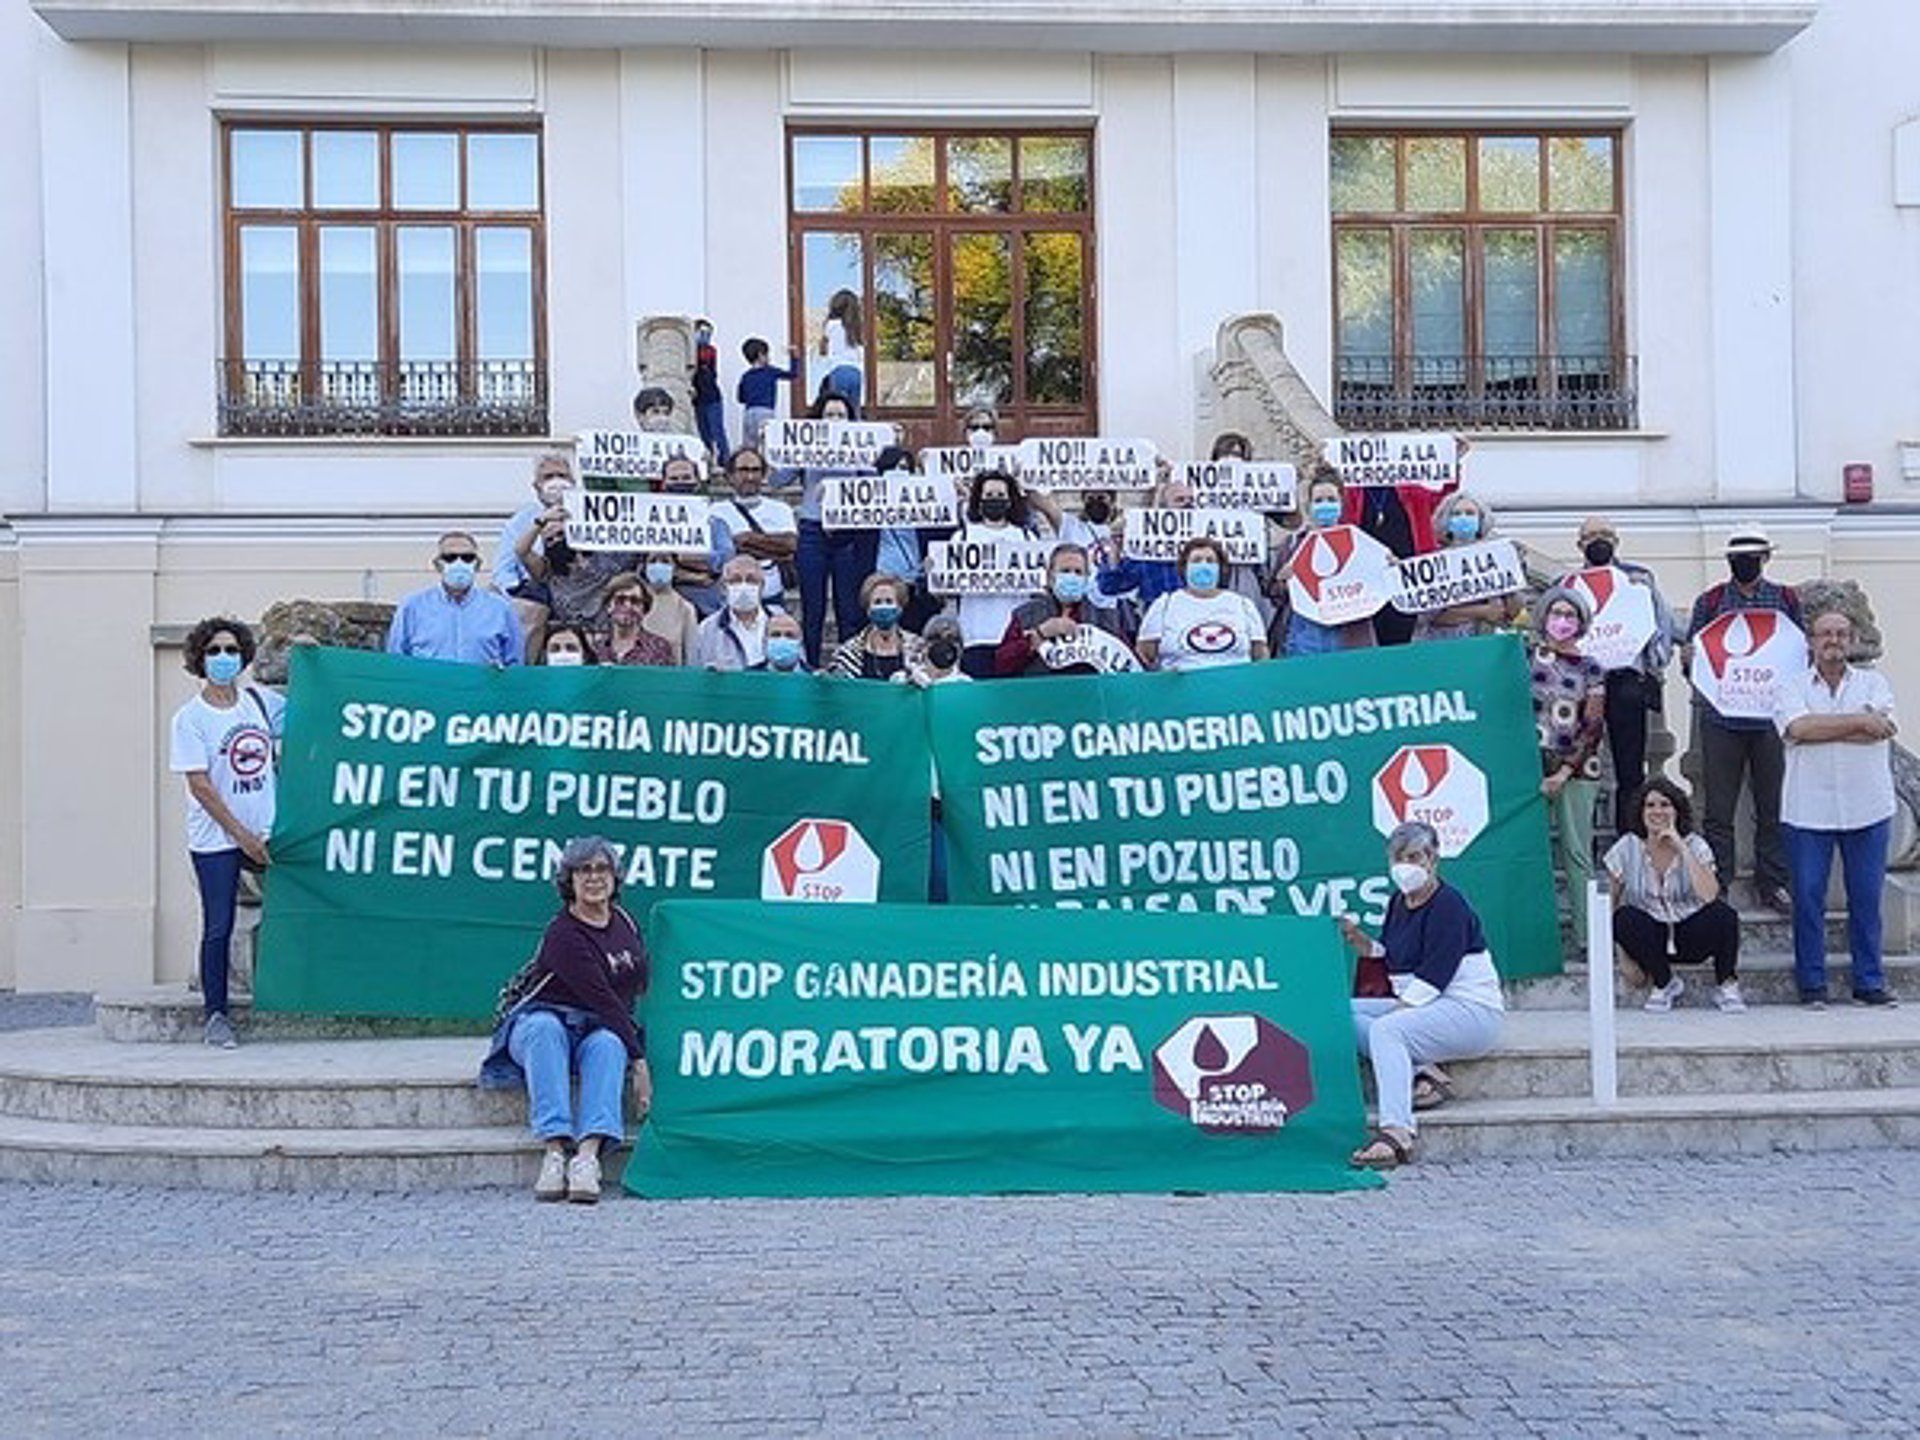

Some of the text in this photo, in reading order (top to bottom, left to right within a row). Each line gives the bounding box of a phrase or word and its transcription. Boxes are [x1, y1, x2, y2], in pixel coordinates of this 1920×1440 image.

[595, 433, 639, 455] NO!!
[652, 442, 662, 457] A
[783, 422, 875, 447] NO!! A LA
[940, 450, 986, 473] NO!!
[1039, 441, 1135, 465] NO!! A LA
[1341, 438, 1437, 463] NO!! A LA
[579, 457, 659, 475] MACROGR
[1023, 469, 1150, 487] MACROGRANJA
[1187, 464, 1278, 488] NO!! A LA
[1343, 464, 1450, 484] ACROGRANJA
[840, 480, 936, 506] NO!! A LA
[1196, 489, 1291, 509] CROGRANJA
[585, 495, 689, 524] NO!! A LA
[825, 506, 952, 526] MACROGRANJA
[569, 525, 705, 545] MACROGRANJA
[1144, 511, 1245, 538] NO!! A LA
[947, 543, 1047, 571] NO!! A LA
[931, 572, 1041, 591] MACROGRAN
[1400, 553, 1498, 589] NO!! A LA
[1392, 571, 1518, 609] MACROGRANJA
[1733, 668, 1774, 683] STOP
[341, 703, 871, 765] STOP GANADERÍA INDUSTRIAL
[976, 690, 1478, 765] STOP GANADERIA INDUSTRIAL
[333, 761, 727, 824] NI EN TU PUEBLO
[983, 760, 1349, 829] NI EN TU PUEBLO
[326, 828, 719, 890] NI EN CENATE
[990, 837, 1301, 893] NI EN POZUELO
[802, 882, 843, 901] STOP
[681, 953, 1280, 1000] STOP GANADERÍA INDUSTRIAL
[679, 1023, 1143, 1078] MORATORIA YA
[1208, 1083, 1267, 1102] STOP
